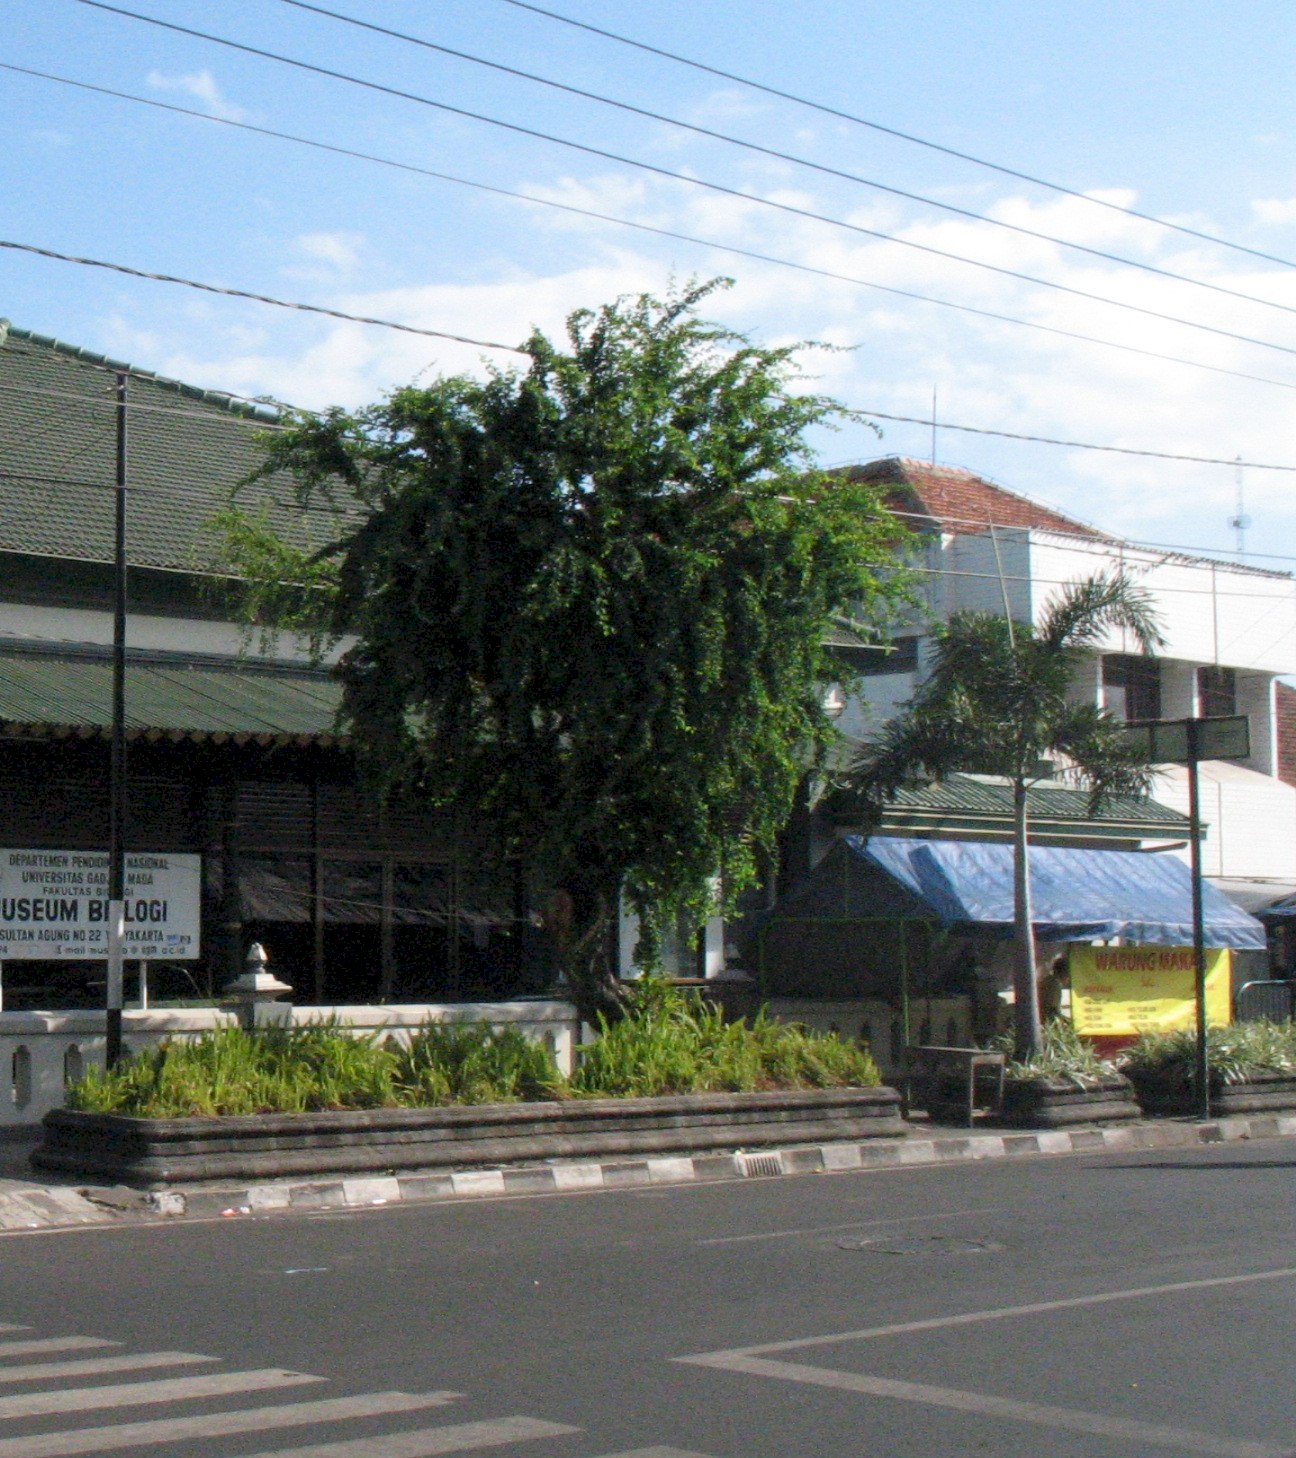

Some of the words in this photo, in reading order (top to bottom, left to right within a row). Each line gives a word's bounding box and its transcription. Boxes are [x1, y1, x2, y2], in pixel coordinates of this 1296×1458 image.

[9, 854, 68, 867] DEPARTEMEN
[127, 857, 169, 869] NASIONAL
[22, 871, 83, 884] UNIVERSITAS
[127, 873, 153, 885] MADA
[43, 887, 91, 896] FAKULTAS
[88, 899, 168, 923] BILOGI
[0, 929, 34, 942] SULTAN
[38, 929, 70, 942] AGUNG
